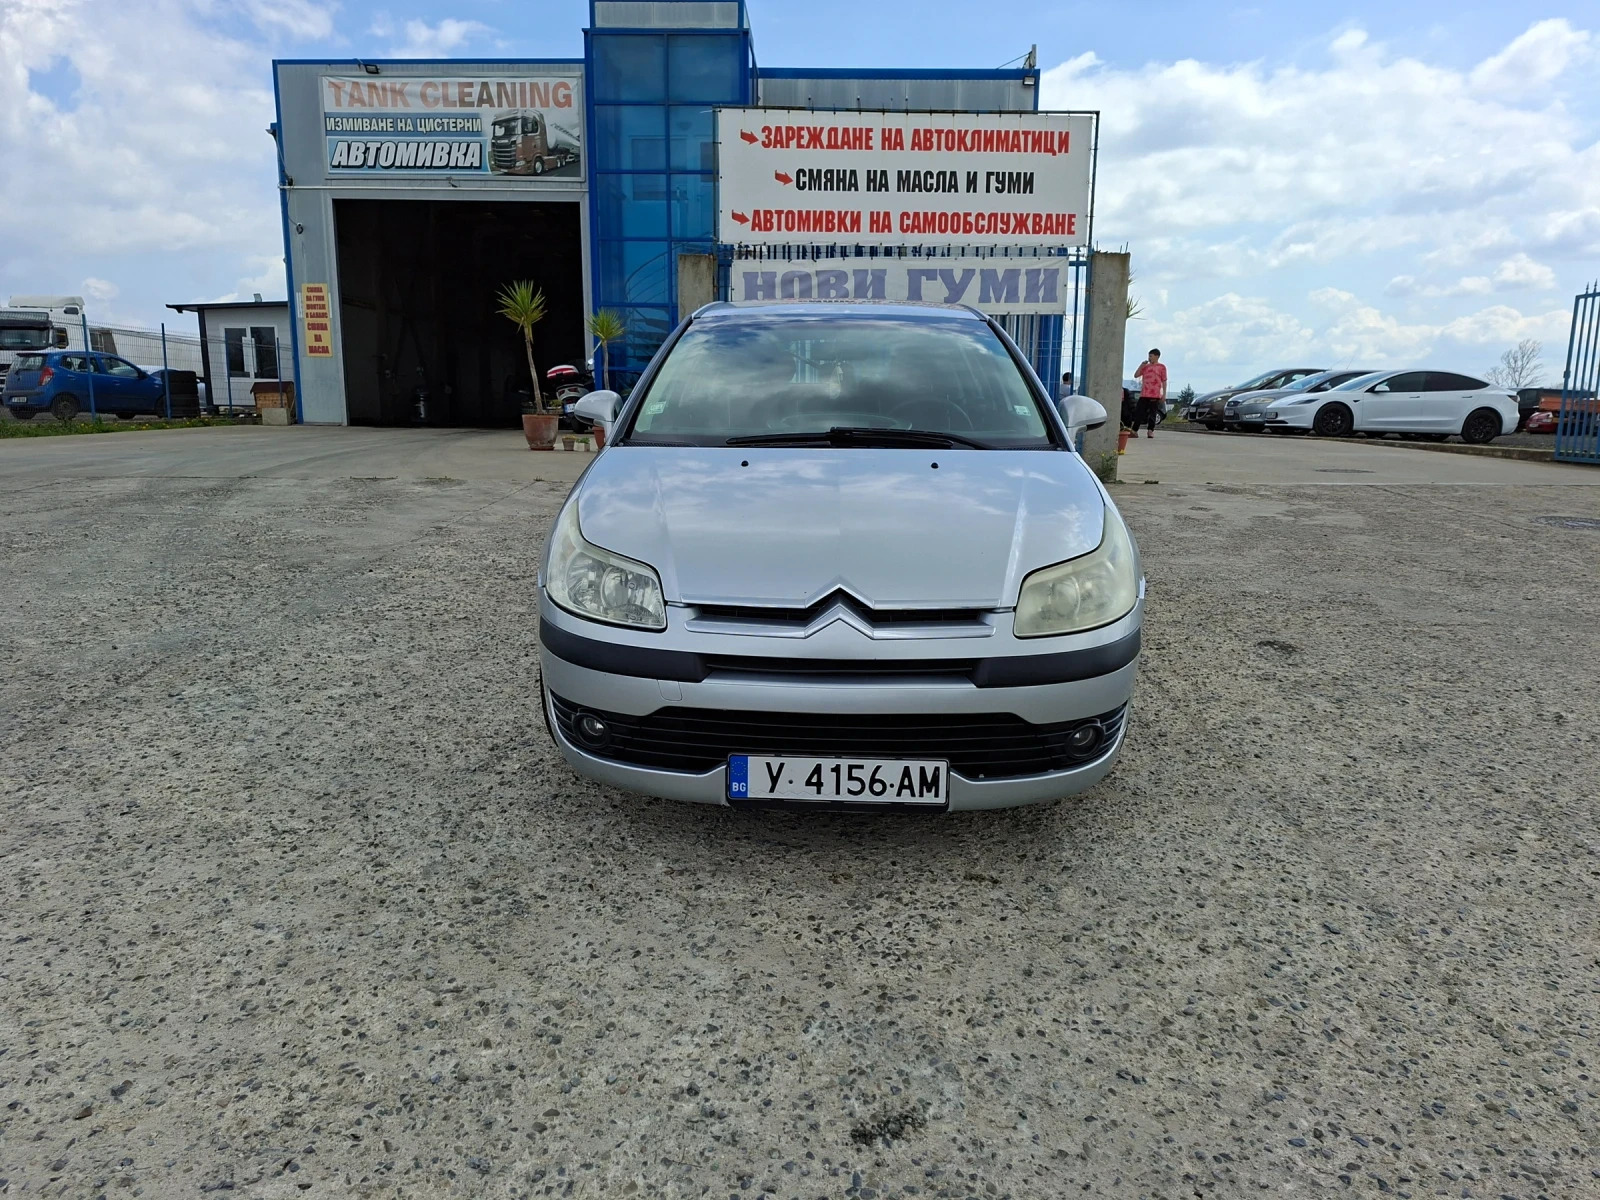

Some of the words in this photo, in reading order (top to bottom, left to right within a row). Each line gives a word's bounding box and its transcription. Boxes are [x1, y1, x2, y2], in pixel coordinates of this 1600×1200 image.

[328, 81, 412, 108] TANK
[419, 81, 573, 109] CLEANING
[326, 117, 394, 132] ИЗМИВАНЕ
[397, 118, 414, 132] НА
[417, 118, 483, 134] ЦИСТЕРНИ
[761, 125, 874, 151] ЗАРЕЖДАНЕ
[881, 127, 905, 151] НА
[910, 128, 1070, 156] АВТОКЛИМАТИЦИ
[331, 140, 482, 170] АВТОМИВКА
[795, 168, 859, 192] СМЯНА
[866, 170, 890, 193] НА
[896, 170, 959, 194] МАСЛА
[966, 171, 978, 194] И
[985, 171, 1035, 195] ГУМИ
[750, 209, 862, 233] АВТОМИВКИ
[869, 211, 893, 234] НА
[899, 211, 1076, 236] САМООБСЛУЖВАНЕ
[742, 268, 887, 301] НОВИ
[906, 268, 1060, 304] ГУМИ
[732, 782, 747, 792] BG
[804, 763, 888, 797] 4156
